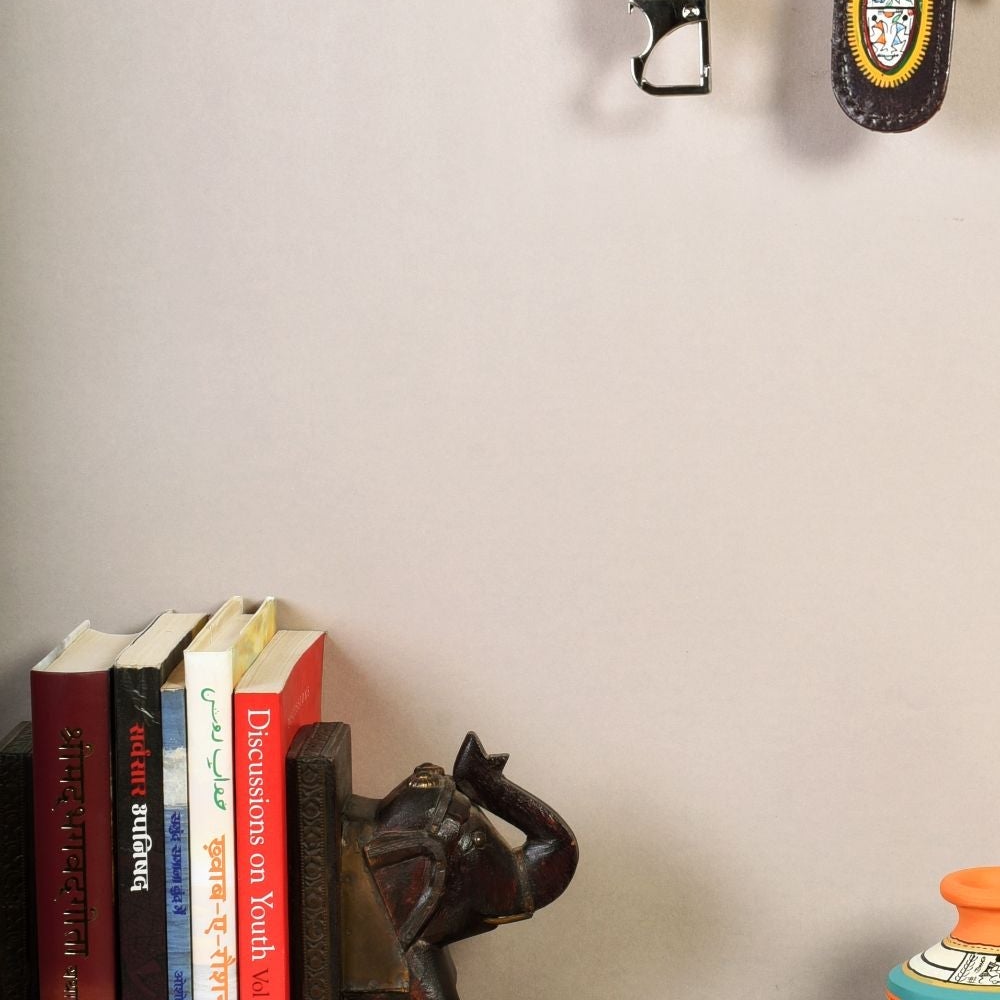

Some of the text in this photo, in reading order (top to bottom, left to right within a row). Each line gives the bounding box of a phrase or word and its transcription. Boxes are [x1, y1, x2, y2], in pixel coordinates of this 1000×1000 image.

[247, 708, 271, 846] Discussions
[130, 802, 153, 892] उपनिषद
[250, 852, 266, 883] on
[251, 889, 275, 962] Youth
